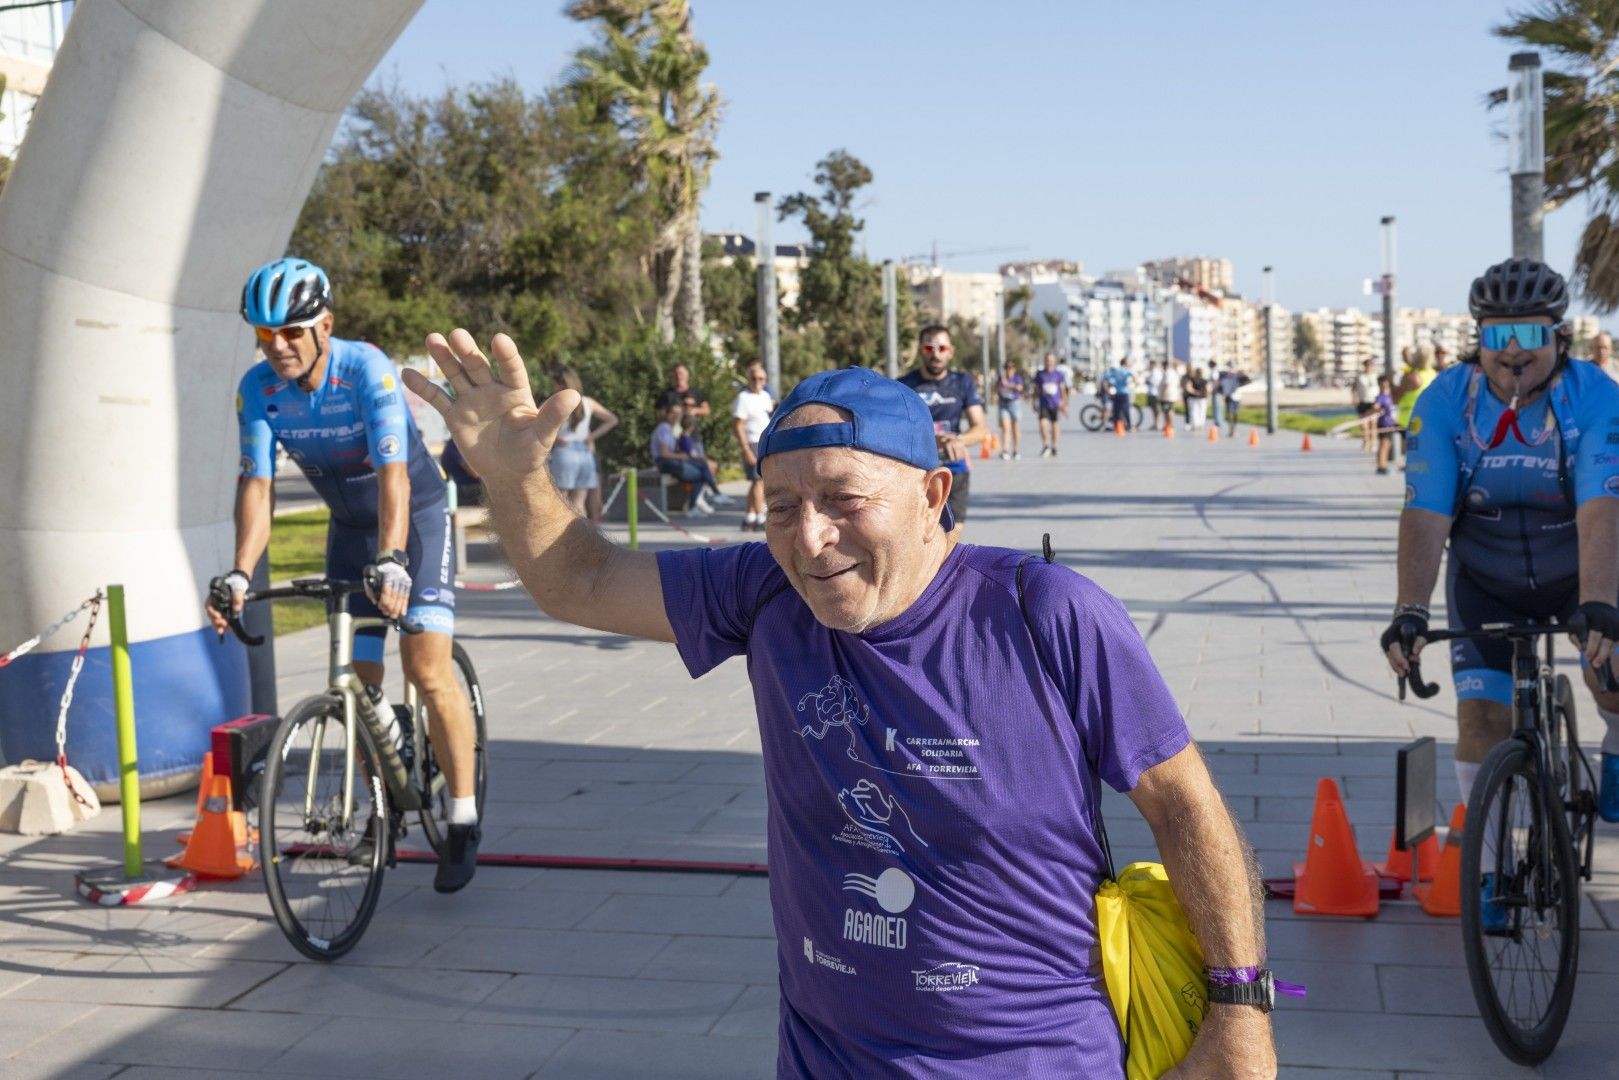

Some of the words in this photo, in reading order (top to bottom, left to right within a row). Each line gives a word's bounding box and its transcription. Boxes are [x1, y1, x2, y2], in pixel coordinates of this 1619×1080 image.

[906, 737, 981, 746] CARRERA/MARCHA
[921, 749, 964, 758] SOLIDARIA
[906, 763, 922, 772] AFA
[928, 765, 978, 773] TORREVIEJA
[843, 908, 907, 950] AGAMED
[815, 954, 857, 976] TORREVIEJA
